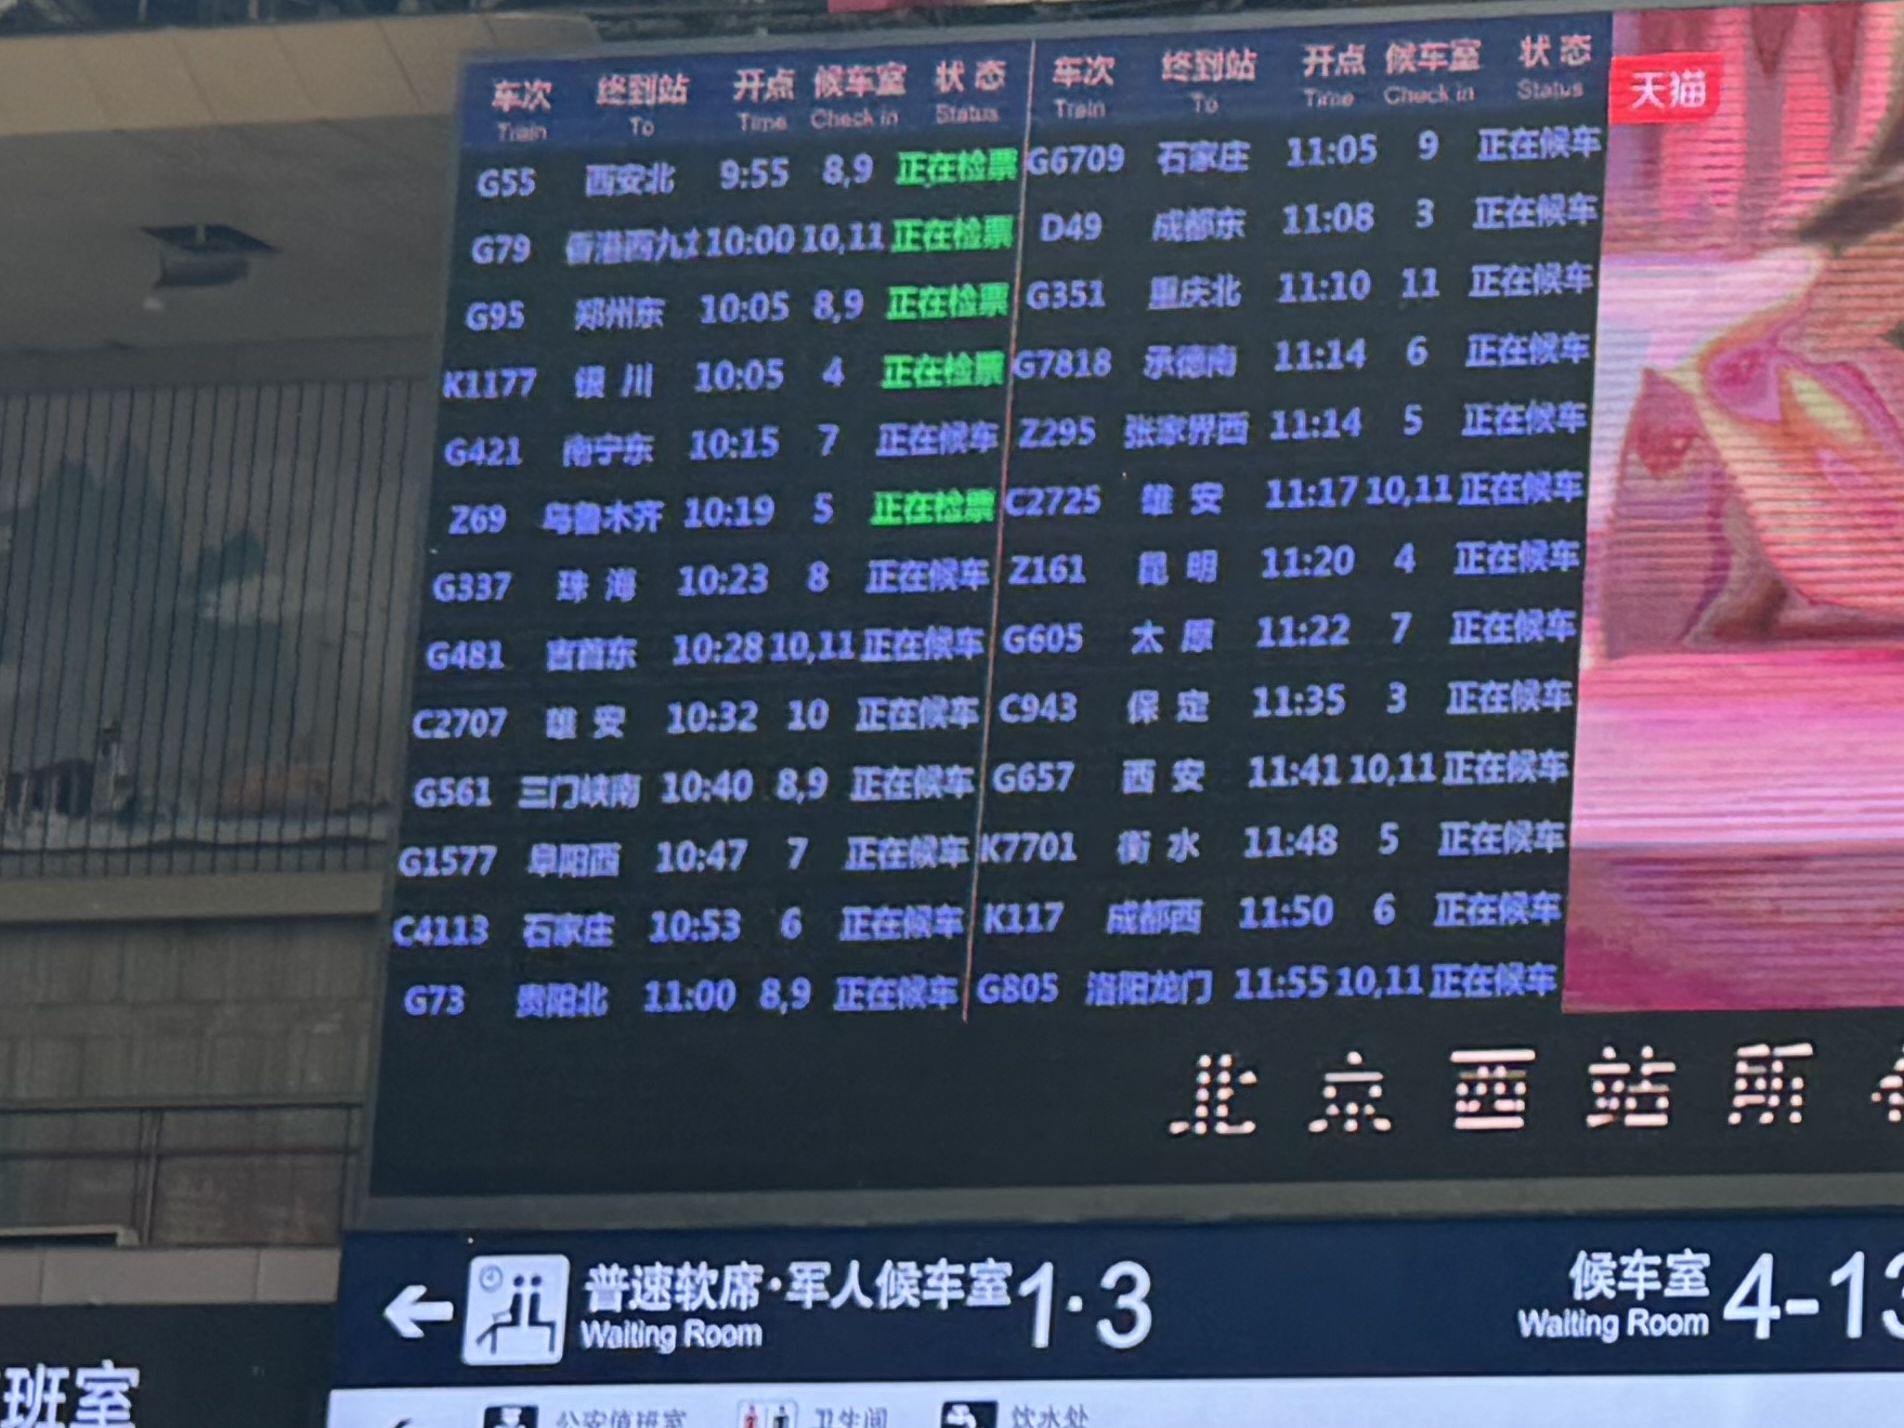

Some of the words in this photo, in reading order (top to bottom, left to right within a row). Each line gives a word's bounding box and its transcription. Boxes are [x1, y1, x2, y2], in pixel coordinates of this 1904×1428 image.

[1627, 64, 1711, 115] 天猫
[477, 167, 535, 197] G55
[721, 157, 788, 189] 9:55
[823, 153, 873, 188] 8,9
[896, 148, 1018, 187] 正在检票
[1027, 144, 1124, 176] G6709
[1288, 134, 1377, 167] 11:05
[1419, 130, 1438, 160] 9
[1478, 126, 1601, 161] 正在候车
[1040, 212, 1102, 241] D49
[1284, 202, 1374, 234] 11:08
[1417, 198, 1434, 228] 3
[1473, 193, 1597, 229] 正在候车
[398, 845, 497, 876] G1577
[657, 839, 748, 872] 10:47
[788, 837, 808, 869] 7
[845, 835, 969, 870] 正在候车
[584, 1258, 1013, 1312] 普速软席·军人候车室
[1569, 1248, 1710, 1300] 候车室
[581, 1320, 677, 1354] Waiting
[683, 1319, 762, 1348] Room
[1518, 1309, 1619, 1343] Waiting
[1627, 1308, 1709, 1336] Room
